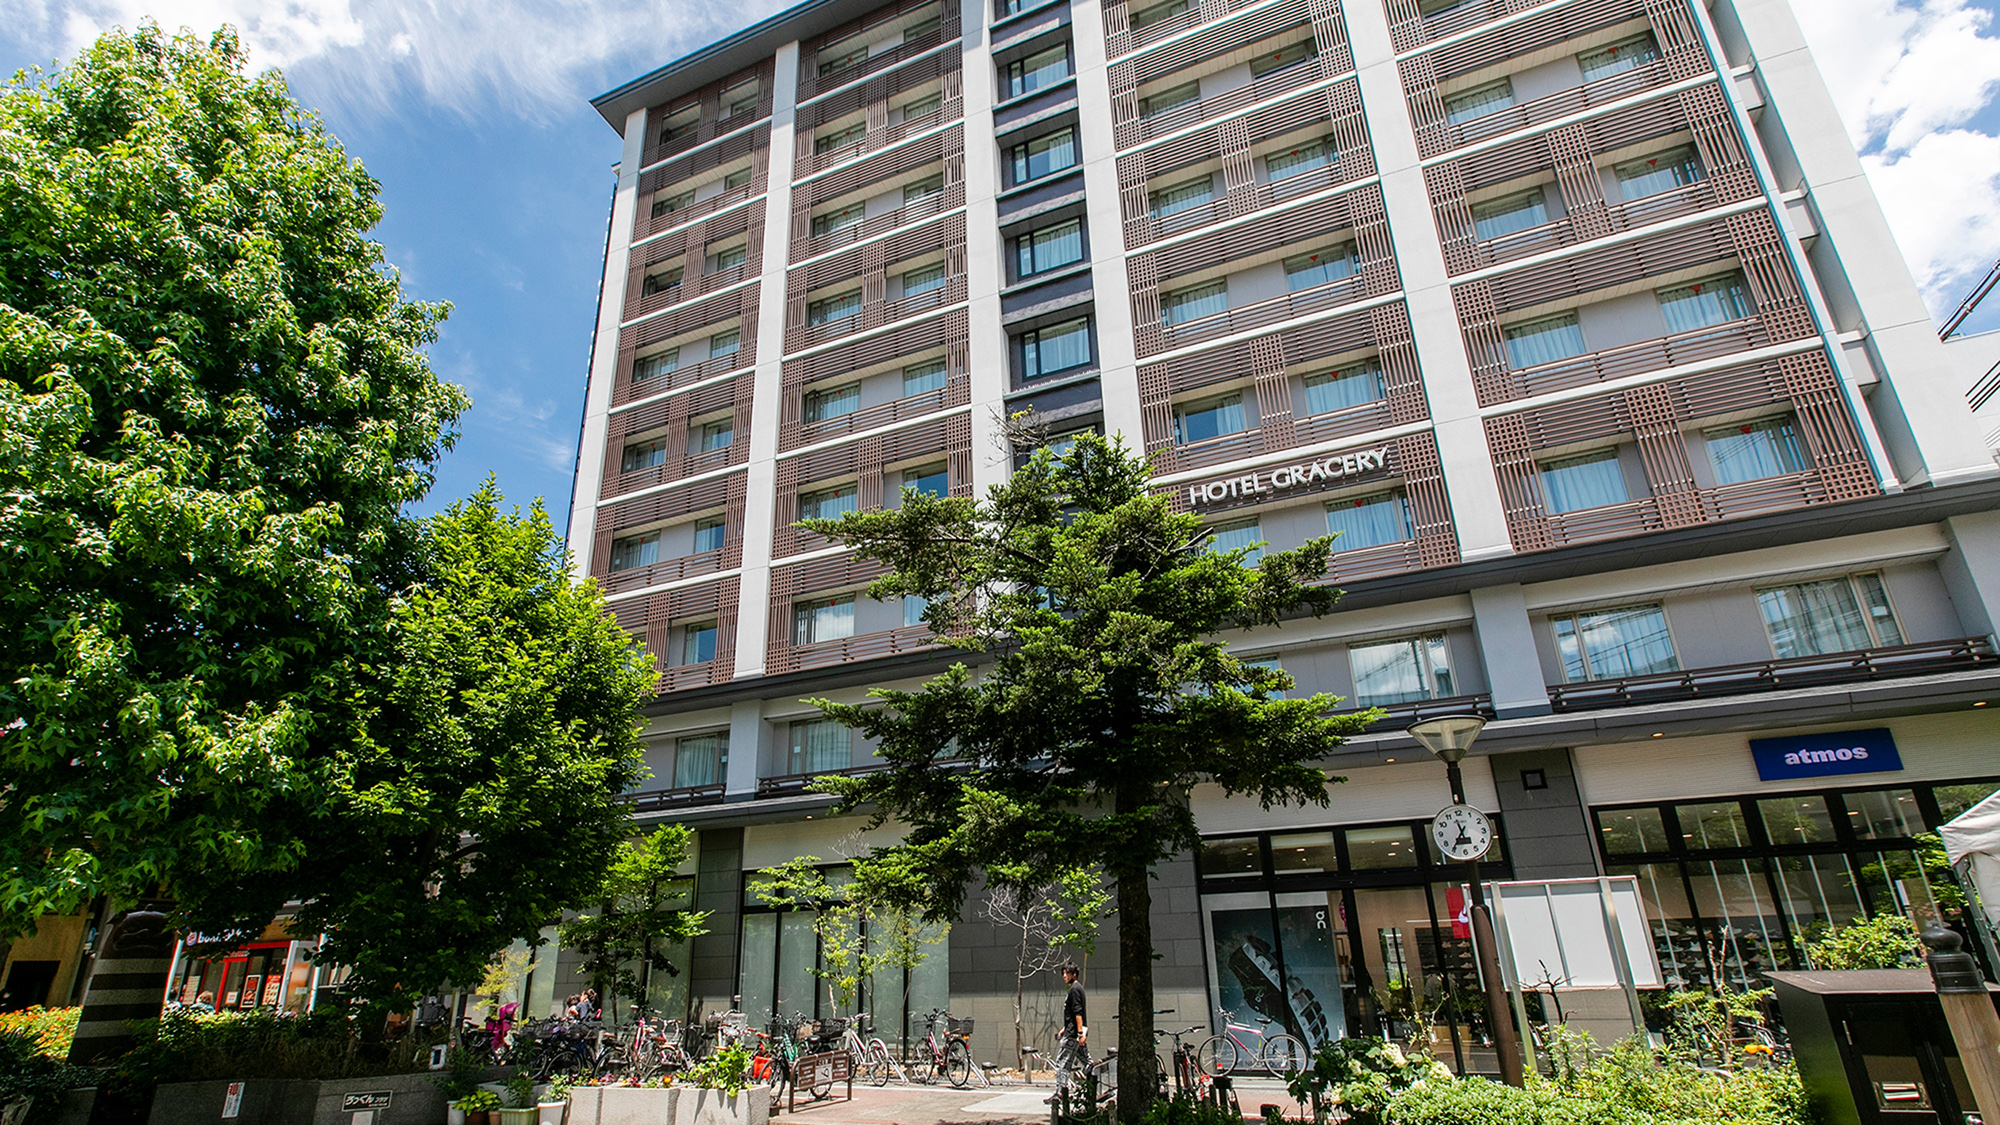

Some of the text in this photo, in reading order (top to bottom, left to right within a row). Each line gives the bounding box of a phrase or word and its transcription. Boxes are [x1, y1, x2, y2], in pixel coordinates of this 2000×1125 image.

[1189, 446, 1388, 505] HOTEL GRACERY
[1784, 747, 1869, 765] atmos
